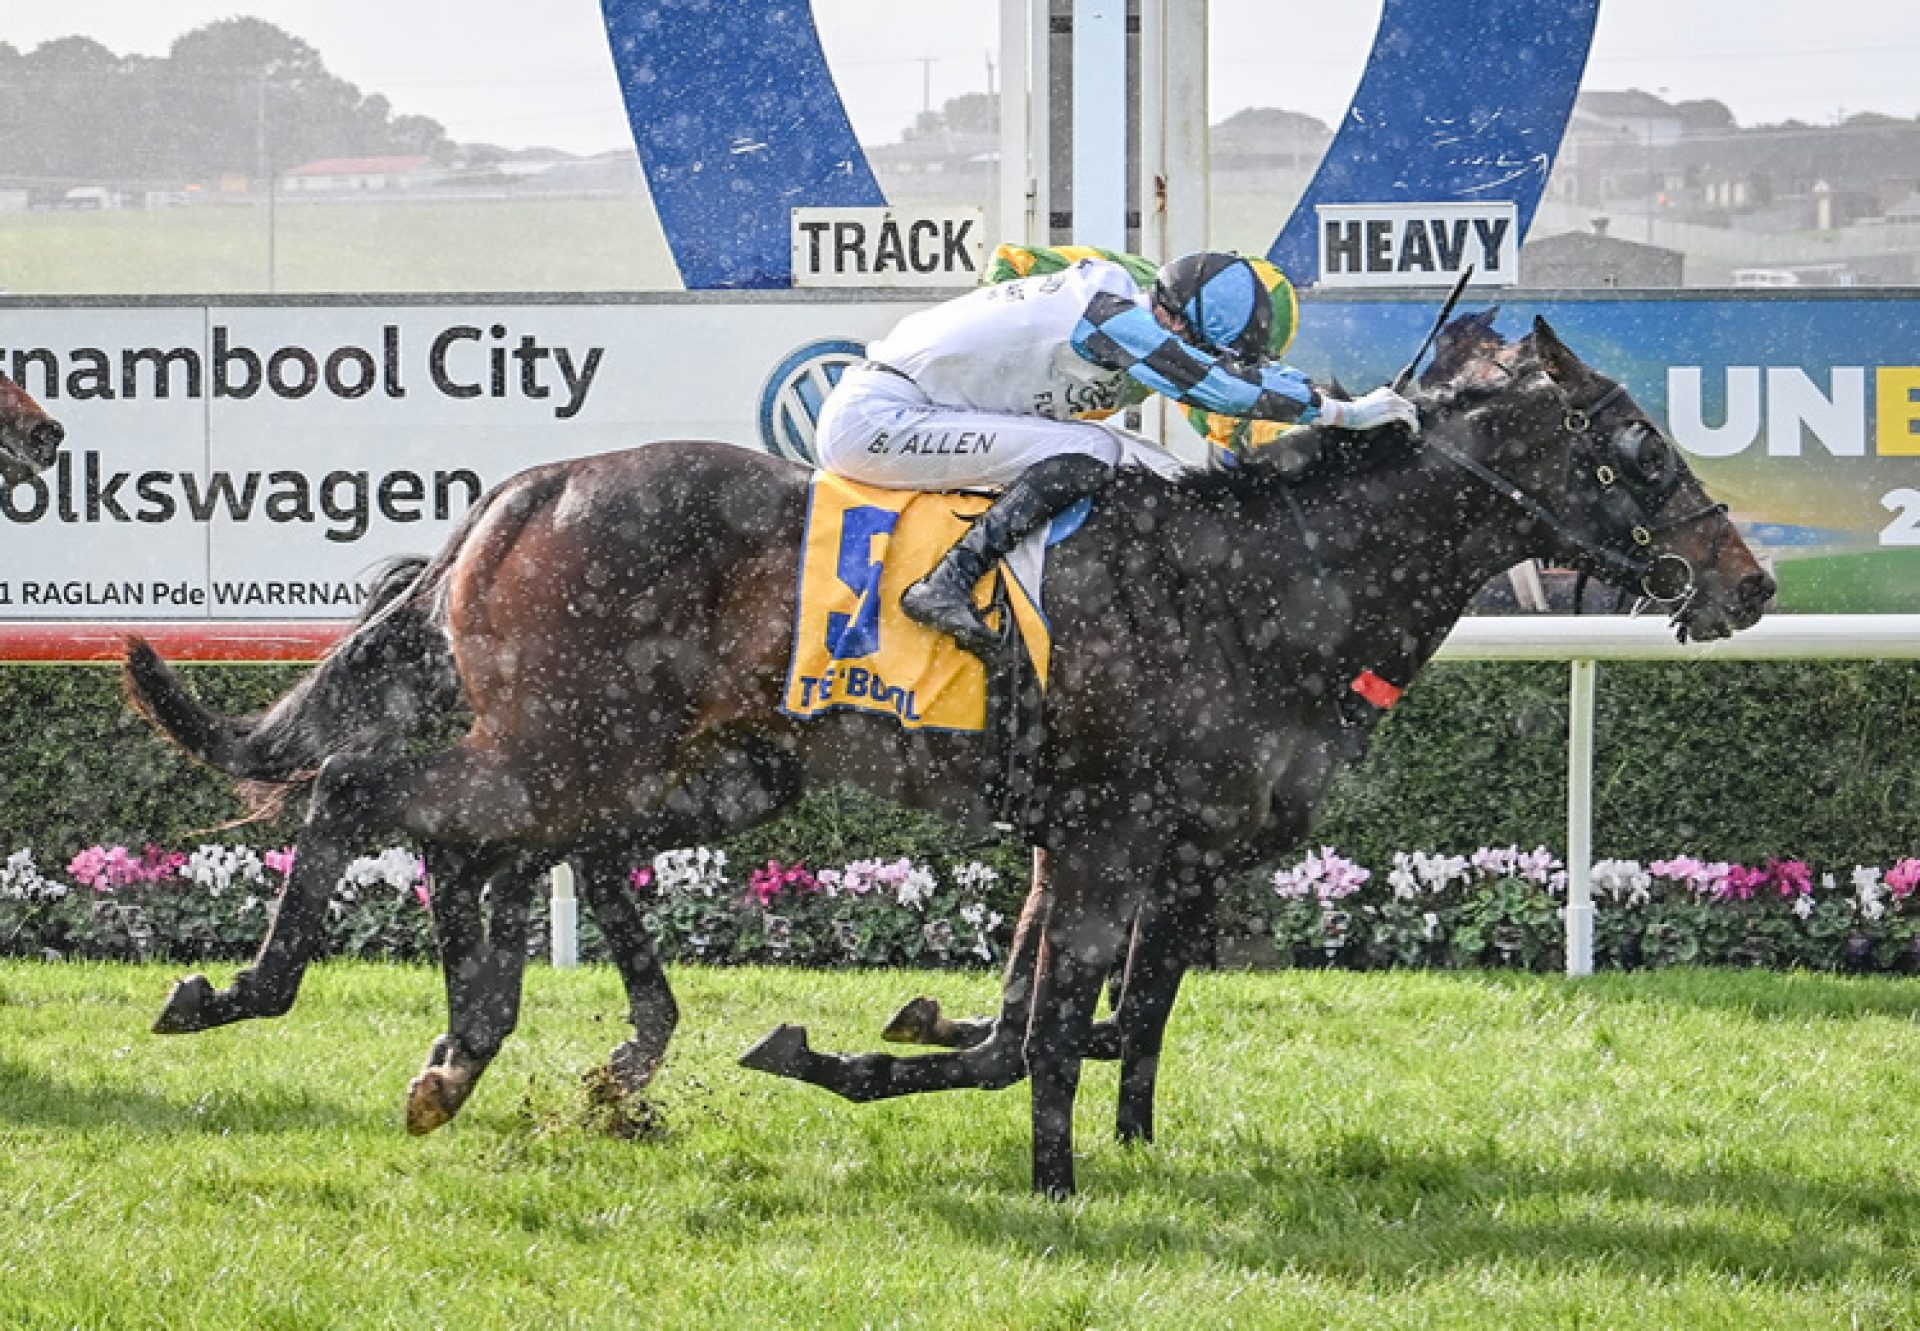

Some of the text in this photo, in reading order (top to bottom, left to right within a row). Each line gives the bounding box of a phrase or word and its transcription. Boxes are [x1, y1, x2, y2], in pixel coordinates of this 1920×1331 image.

[799, 219, 976, 274] TRACK
[1325, 219, 1511, 273] HEAVY
[428, 325, 604, 418] City
[899, 432, 996, 453] ALLEN
[22, 581, 144, 605] RAGLAN
[152, 581, 206, 605] Pde
